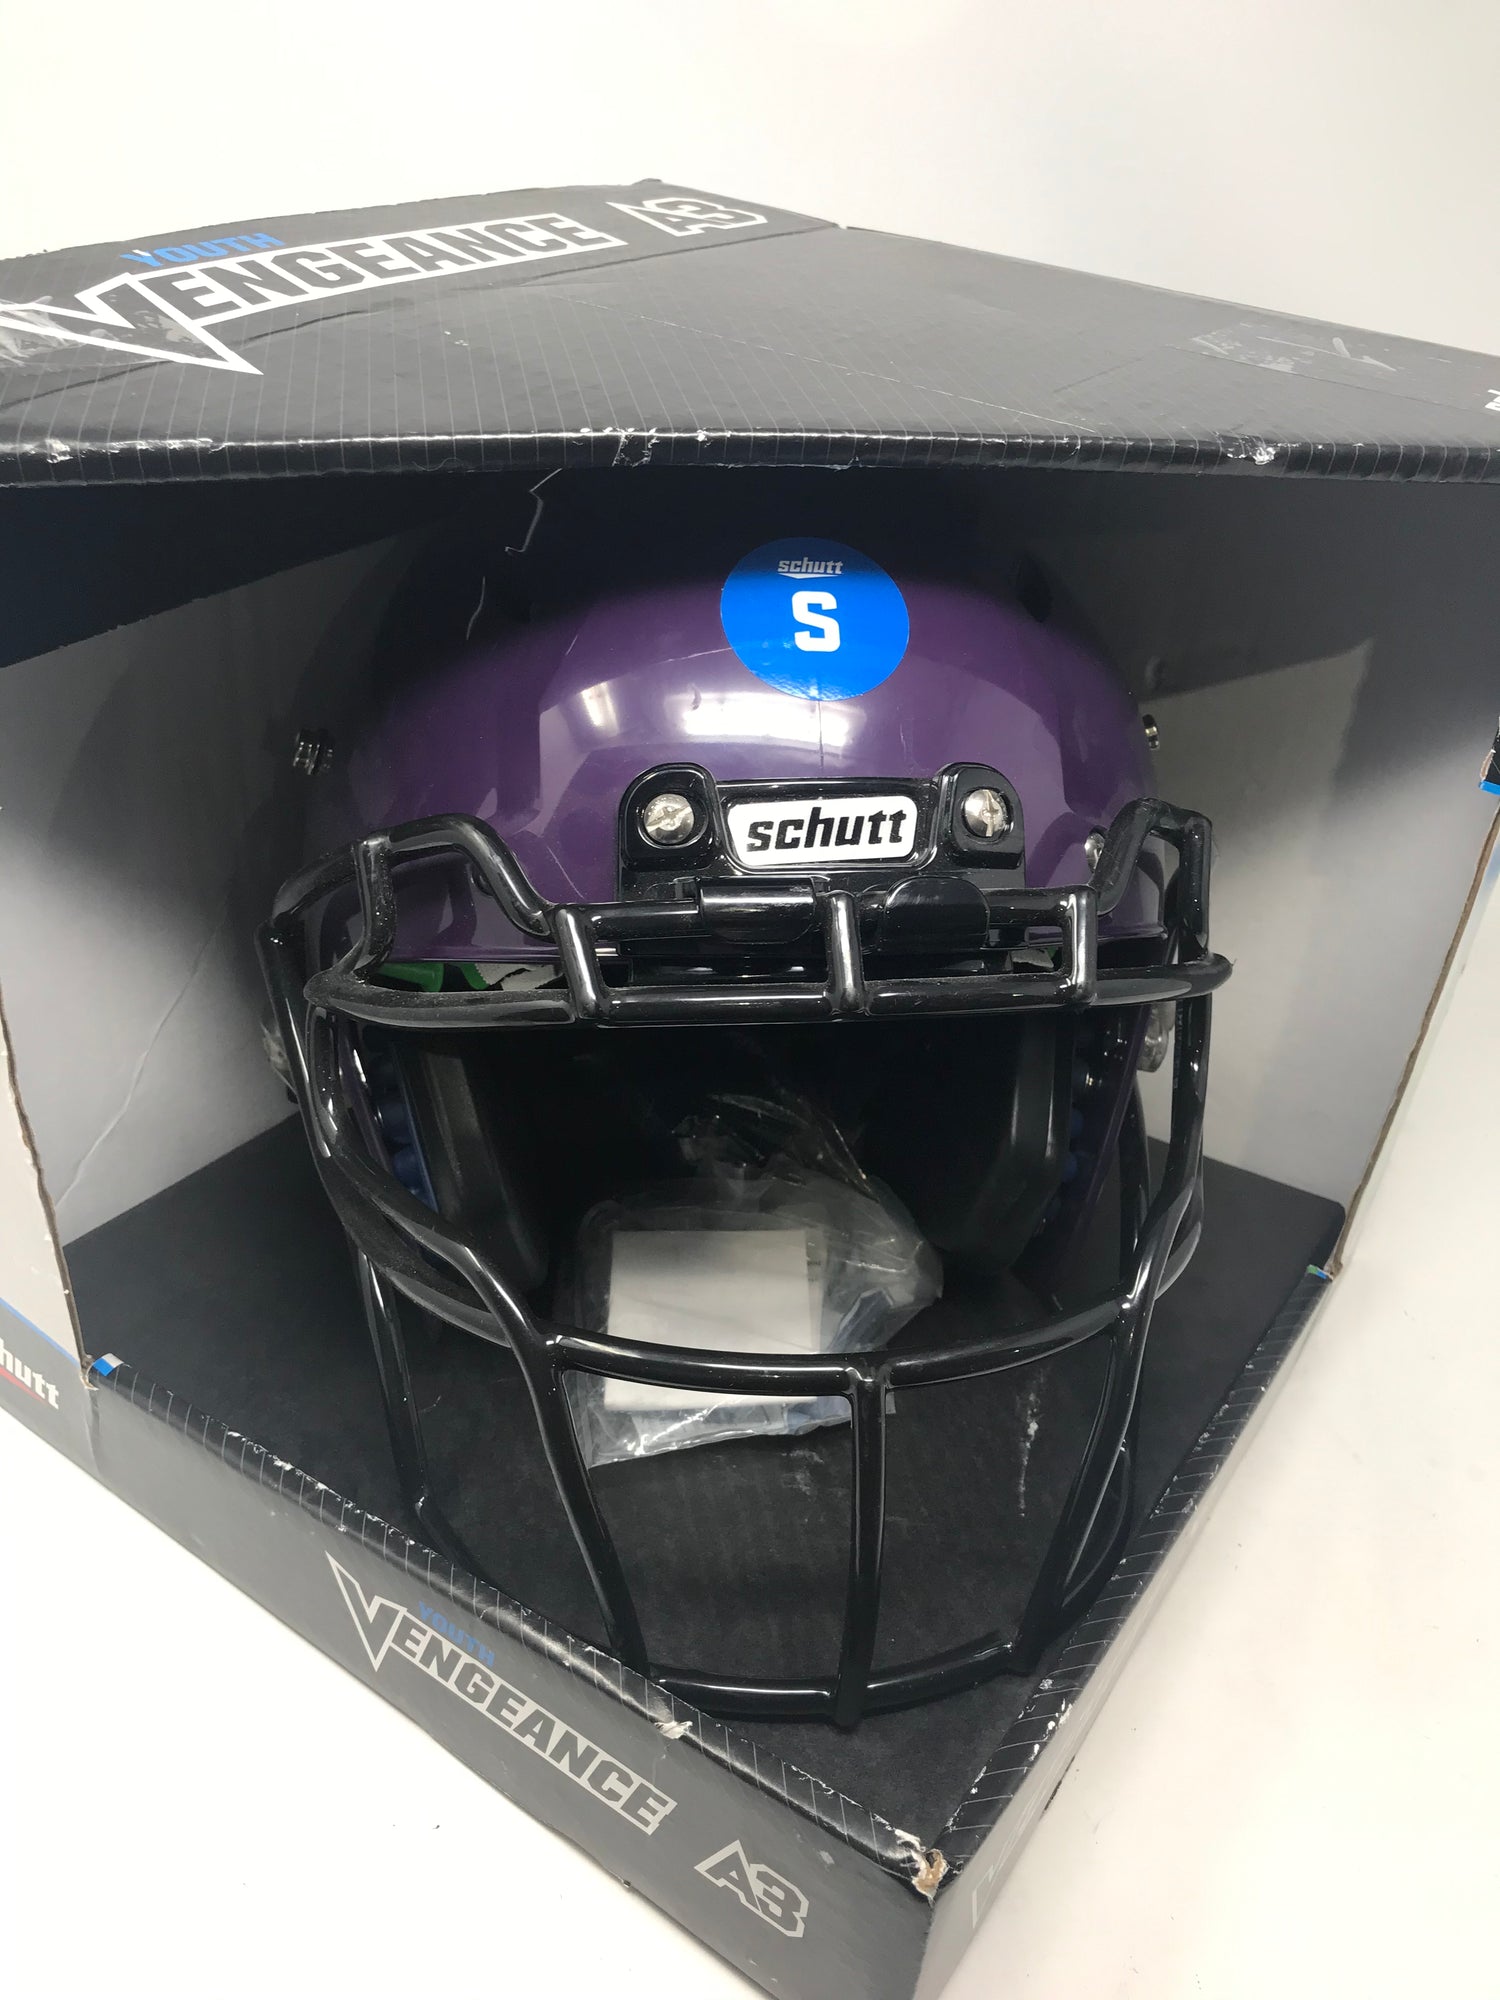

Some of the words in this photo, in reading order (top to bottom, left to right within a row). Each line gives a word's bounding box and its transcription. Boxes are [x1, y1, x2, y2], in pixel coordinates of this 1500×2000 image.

[120, 232, 286, 267] YOUTH
[0, 212, 628, 375] VENGEANCE
[606, 197, 768, 237] A3
[777, 557, 843, 575] schutt
[792, 590, 841, 652] S
[746, 806, 907, 852] schutt
[418, 1600, 496, 1668] YOUTH
[325, 1551, 678, 1836] VENGEANCE
[695, 1840, 809, 1937] A3
